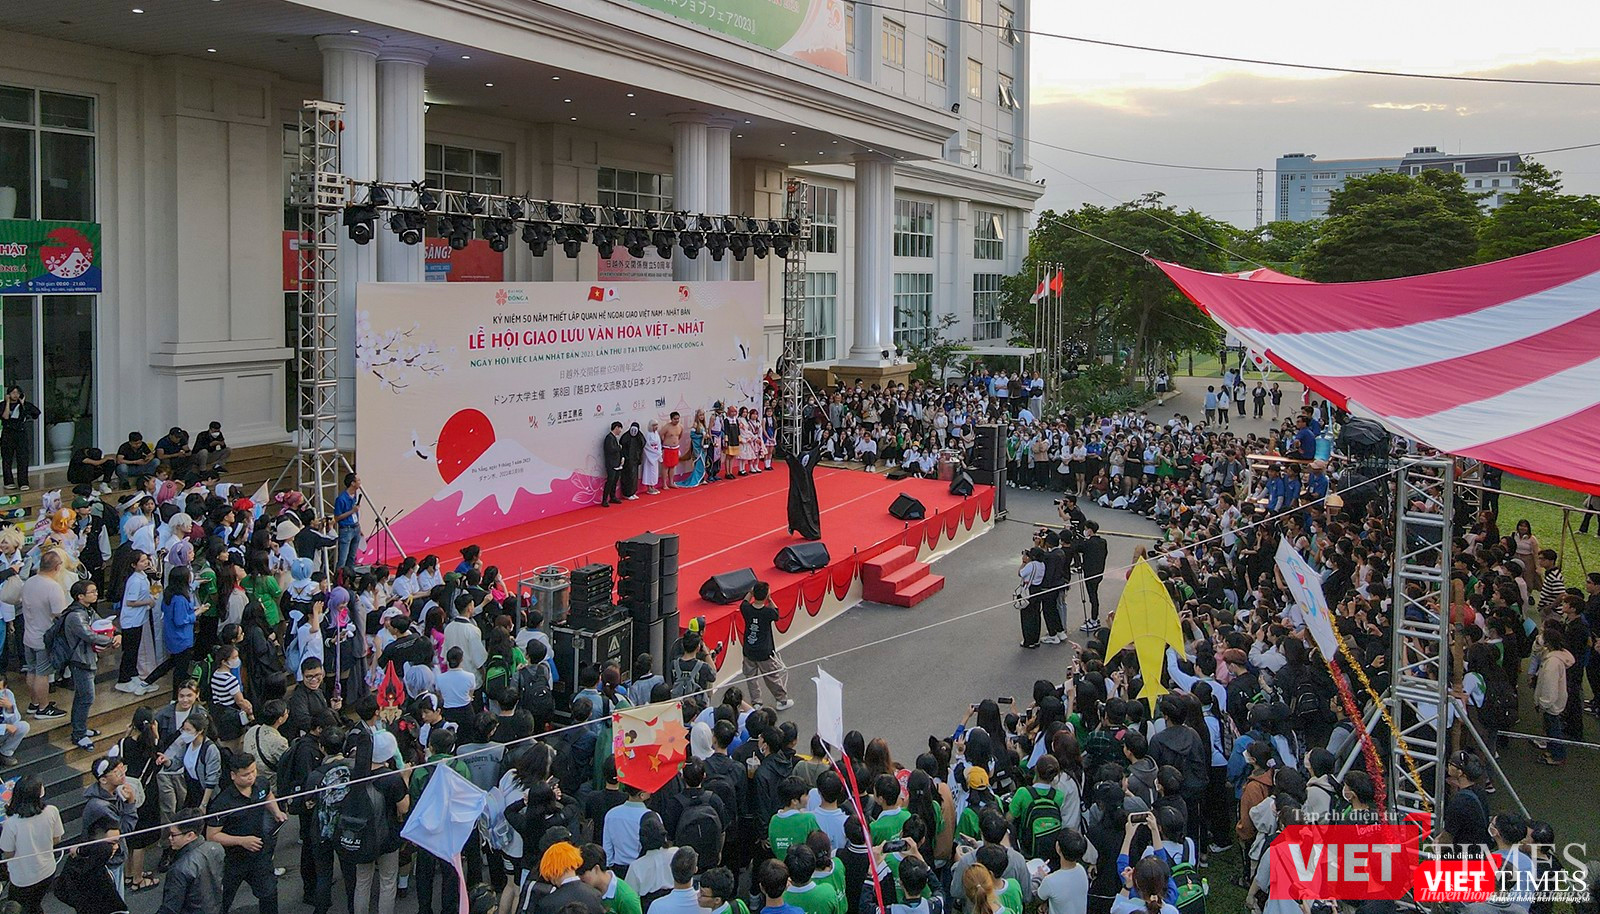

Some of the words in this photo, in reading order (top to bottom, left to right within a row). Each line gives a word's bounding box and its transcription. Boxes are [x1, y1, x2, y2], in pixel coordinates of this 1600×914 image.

[533, 314, 548, 322] NĂM
[581, 311, 598, 320] QUAN
[626, 310, 638, 319] GIAO
[469, 326, 485, 349] LỄ
[492, 328, 519, 351] HỘI
[523, 329, 557, 346] GIAO
[561, 327, 585, 343] LƯU
[617, 322, 642, 339] HÓA
[646, 320, 668, 339] VIỆT
[678, 318, 704, 336] NHẬT
